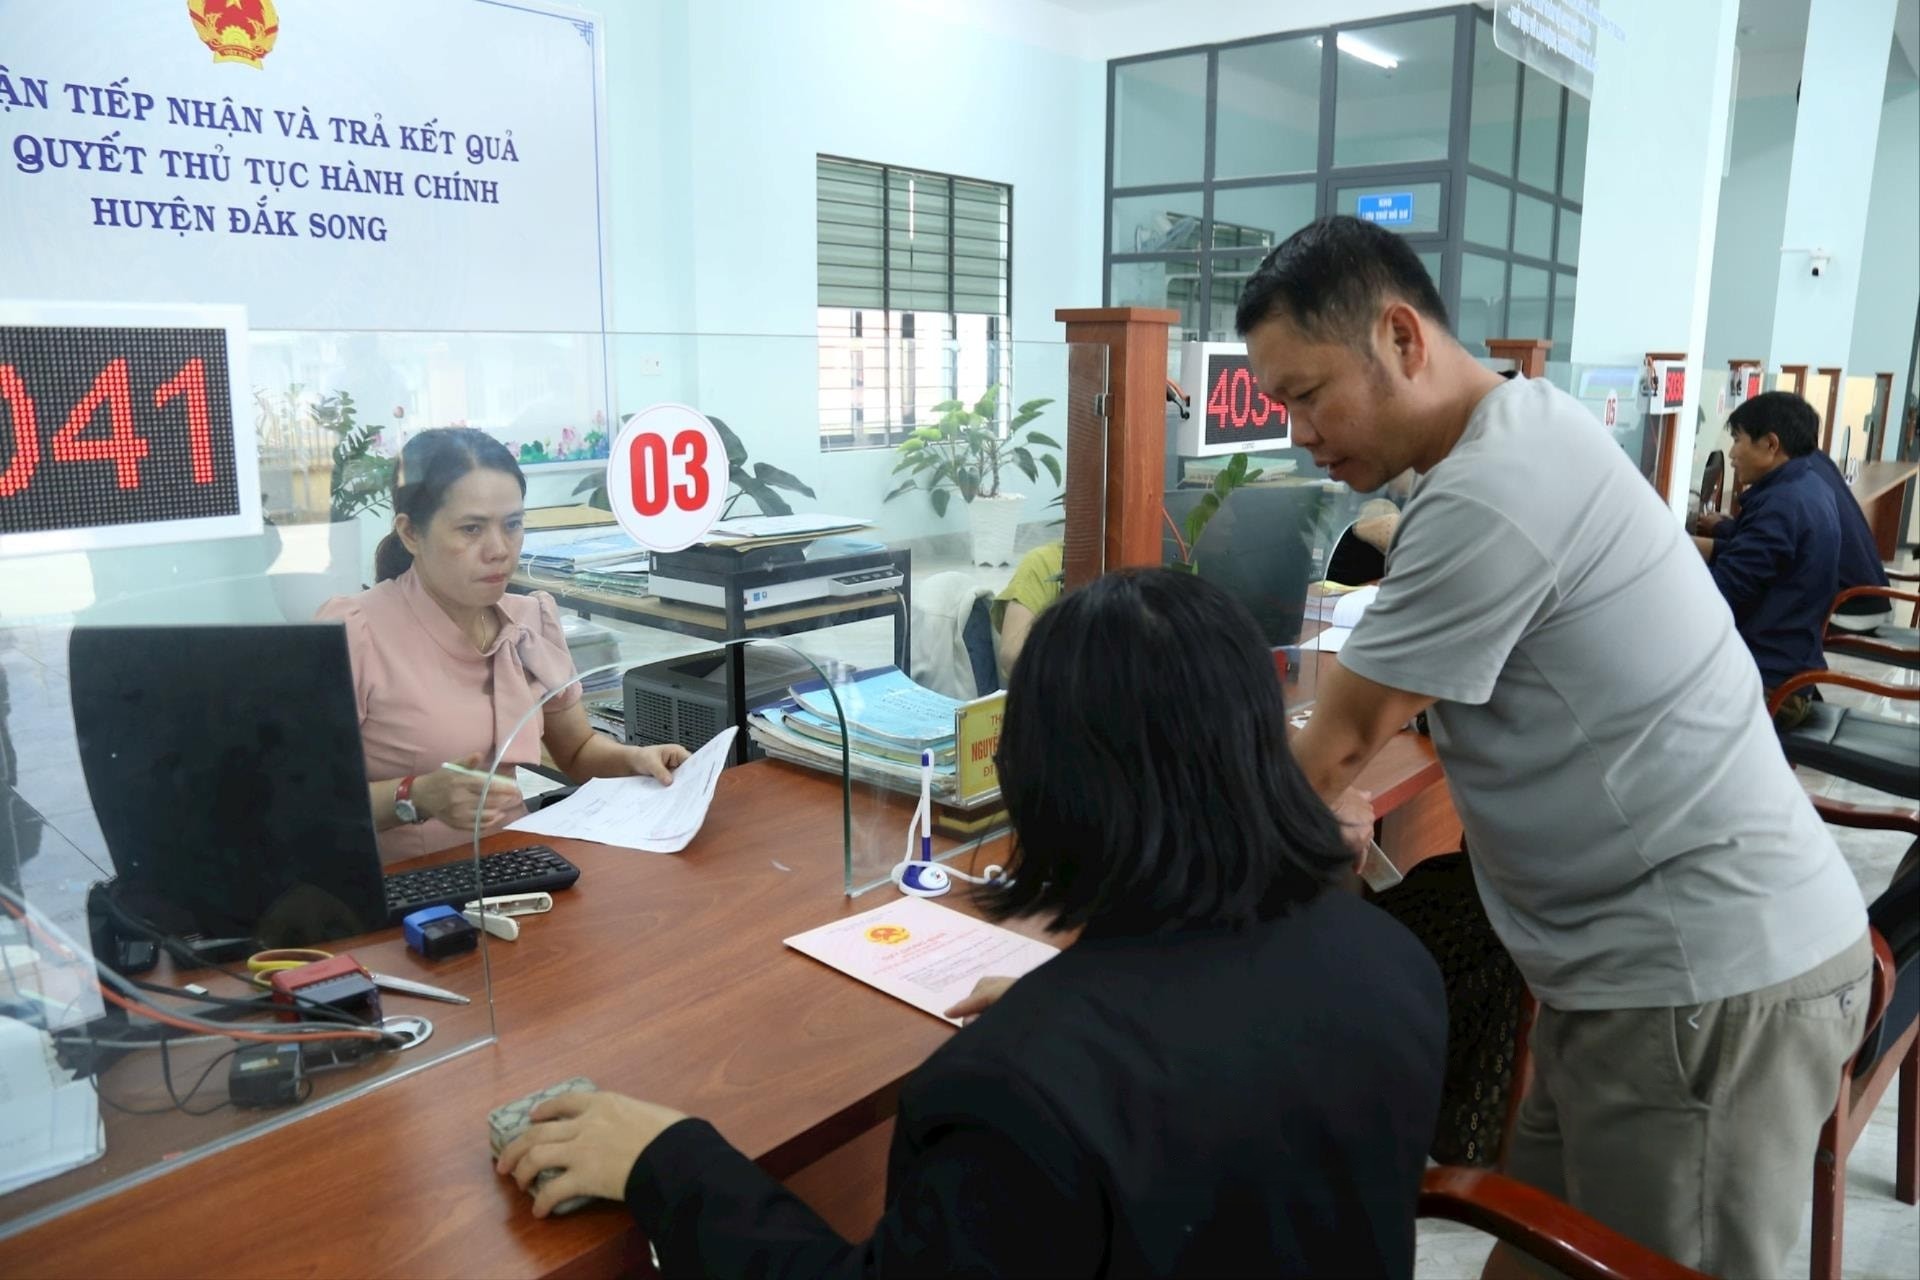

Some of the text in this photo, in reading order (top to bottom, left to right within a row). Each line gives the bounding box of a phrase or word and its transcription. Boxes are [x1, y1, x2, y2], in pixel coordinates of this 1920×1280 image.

[63, 76, 155, 121] TIẾP
[166, 96, 263, 138] NHẬN
[273, 105, 319, 140] VÀ
[328, 112, 391, 148] TRẢ
[399, 118, 456, 155] KẾT
[465, 130, 520, 165] QUẢ
[13, 130, 500, 204] QUYẾT THỦ TỤC HÀNH CHÍNH
[90, 194, 388, 242] HUYỆN ĐẮK SONG
[629, 429, 710, 517] 03
